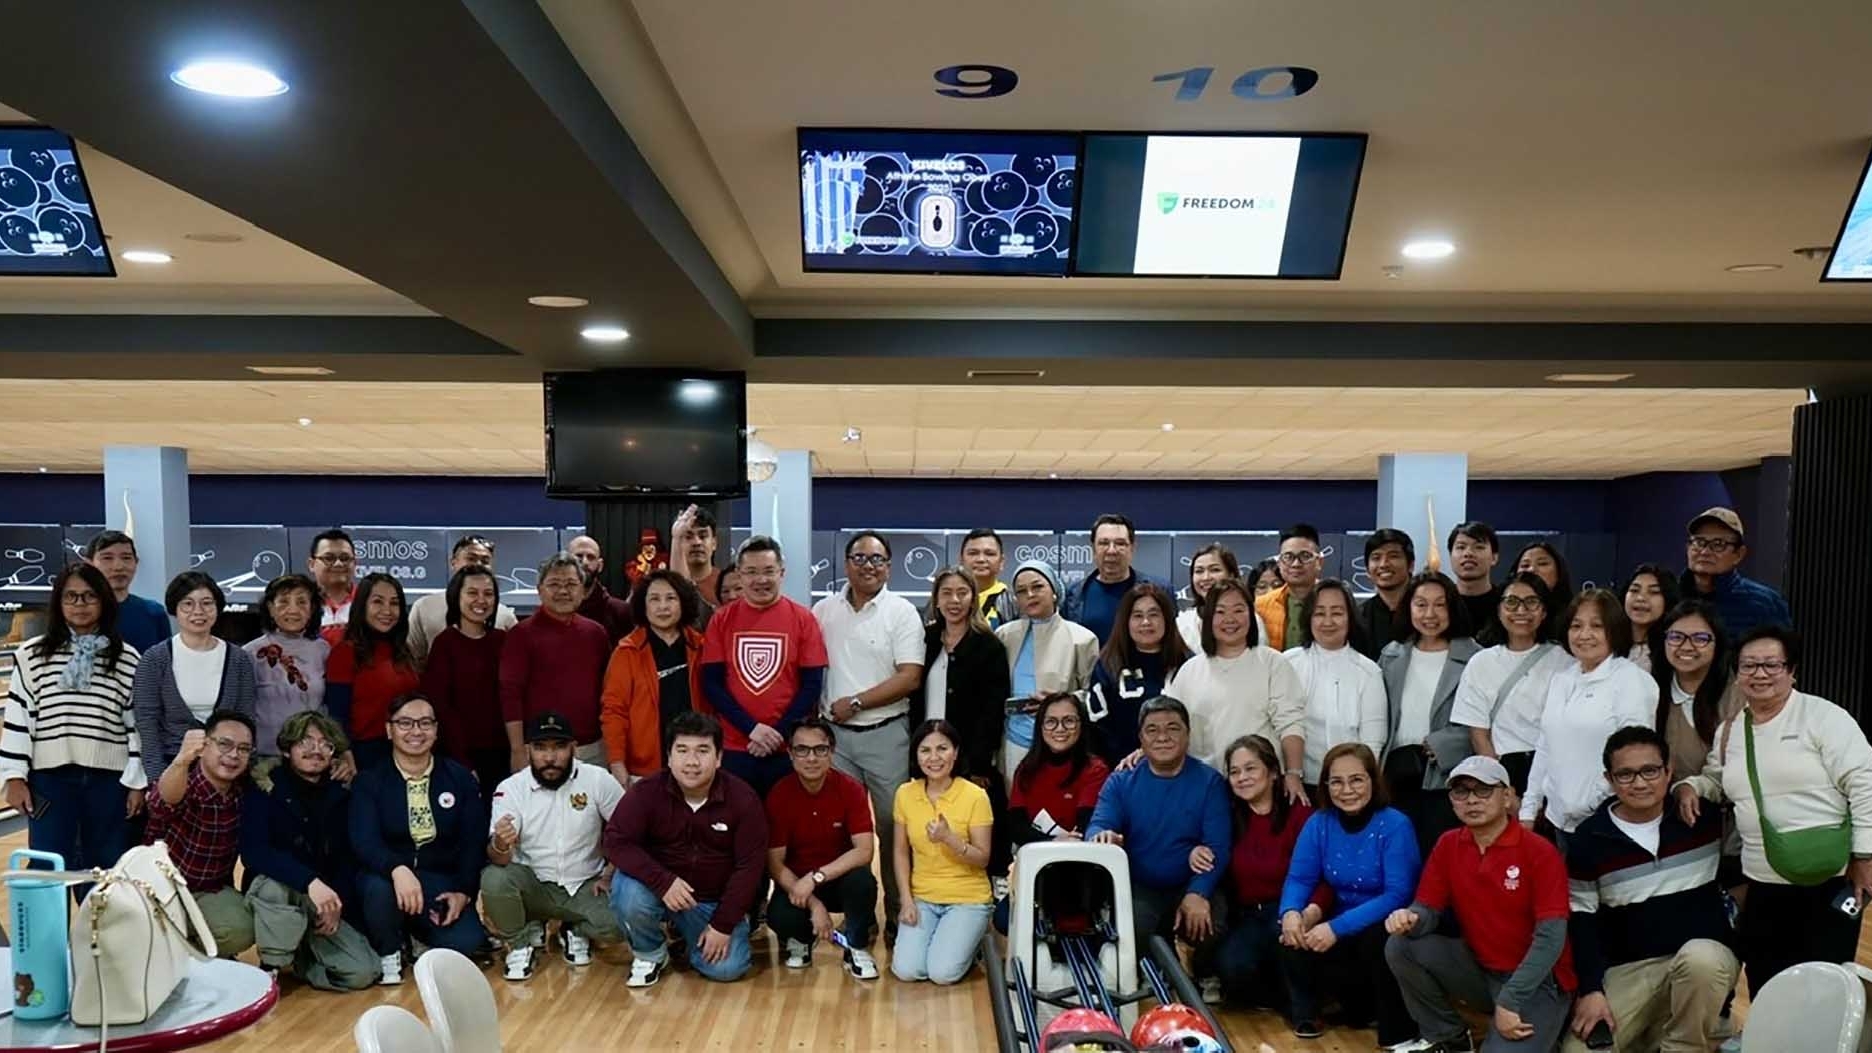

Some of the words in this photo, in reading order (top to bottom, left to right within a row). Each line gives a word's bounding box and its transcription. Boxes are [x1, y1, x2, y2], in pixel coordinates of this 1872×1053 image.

[934, 64, 1018, 98] 9
[1152, 67, 1319, 101] 10
[353, 540, 428, 560] smos
[1015, 545, 1093, 564] cosm
